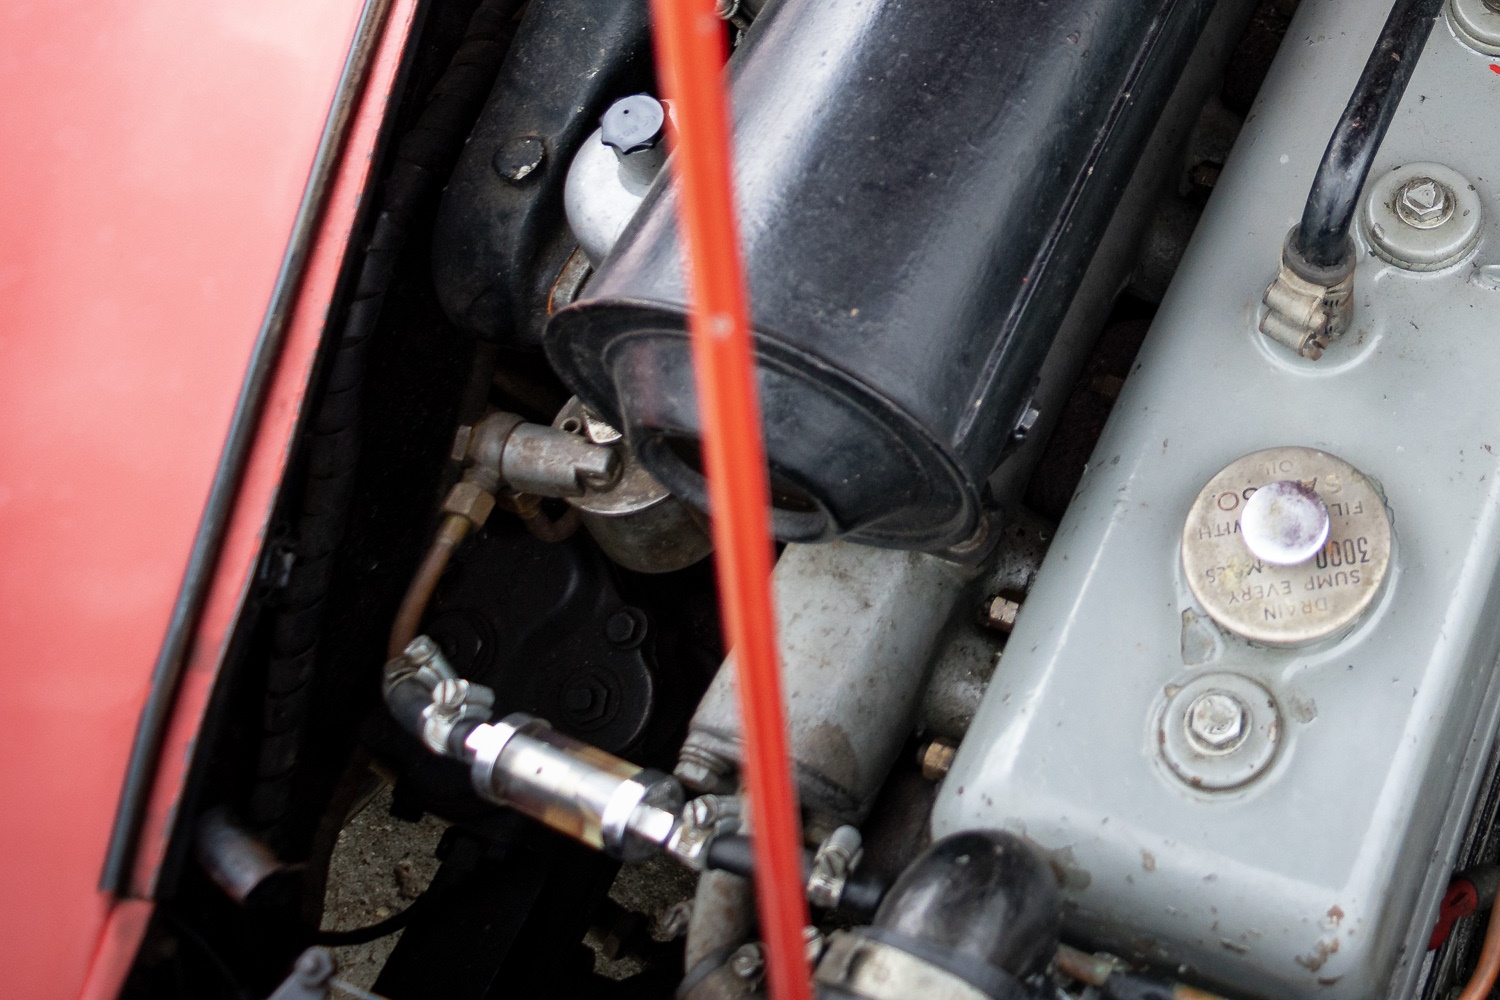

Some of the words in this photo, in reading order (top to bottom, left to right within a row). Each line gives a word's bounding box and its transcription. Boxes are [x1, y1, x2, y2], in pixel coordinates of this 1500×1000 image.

[1323, 500, 1364, 518] FIL
[1315, 536, 1370, 569] 3000
[1304, 570, 1361, 591] SUMP
[1228, 581, 1291, 604] EVERY
[1264, 597, 1328, 621] DRAIN
